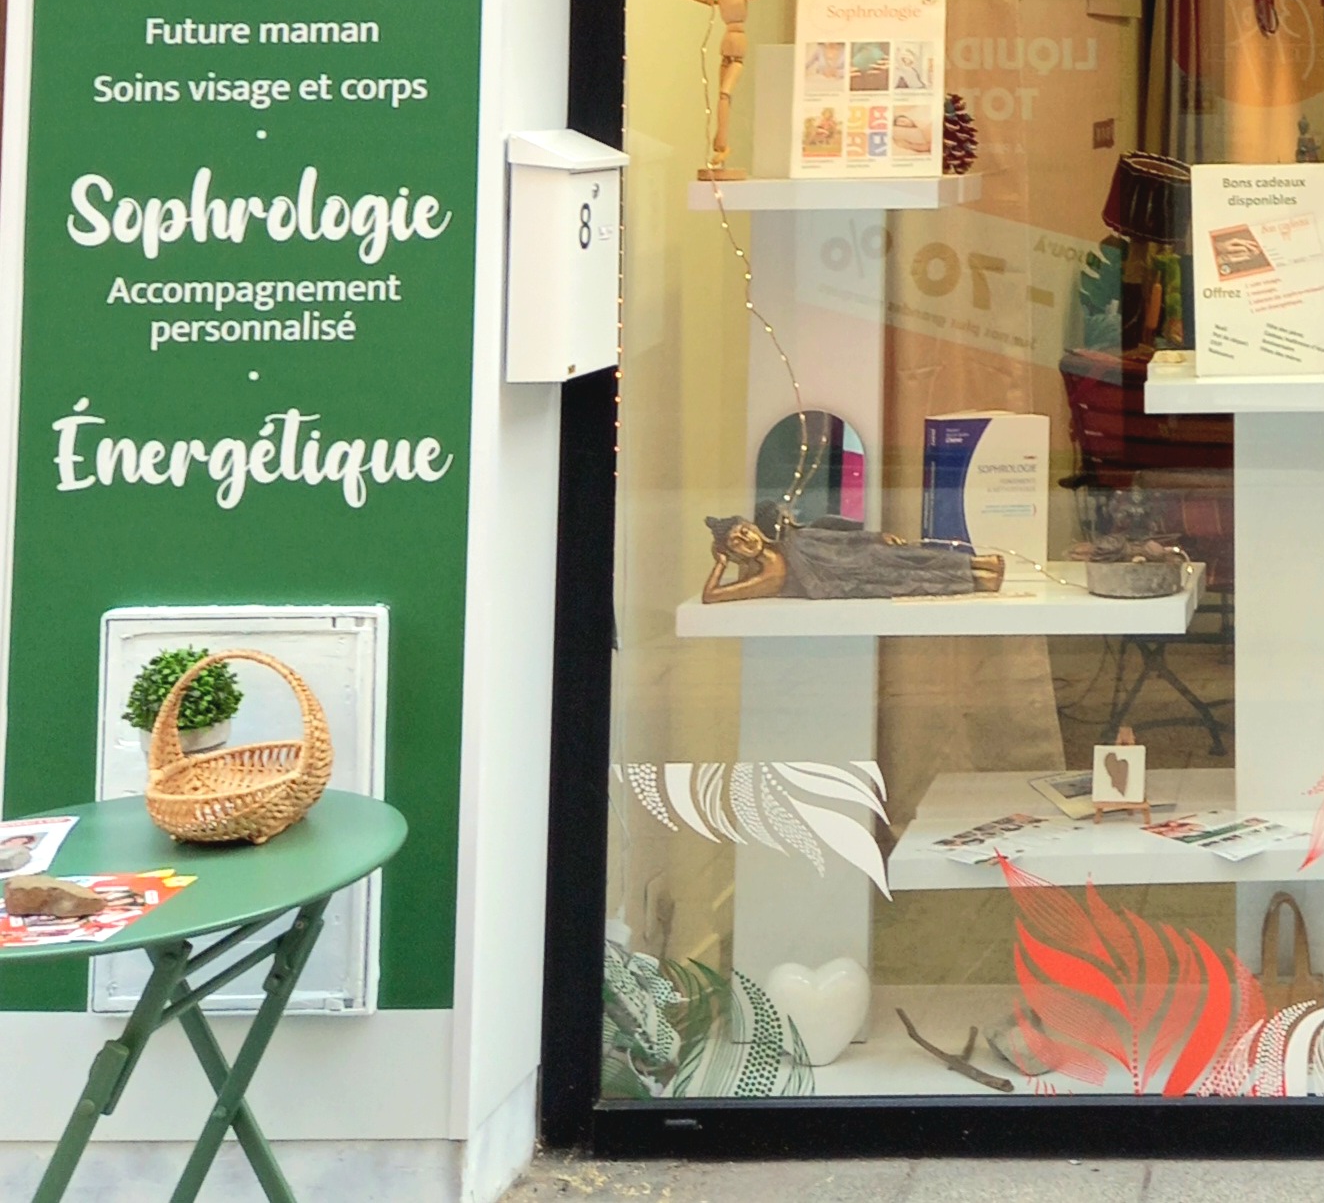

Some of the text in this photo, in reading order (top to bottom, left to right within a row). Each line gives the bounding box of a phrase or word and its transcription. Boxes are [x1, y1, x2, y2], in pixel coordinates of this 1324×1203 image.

[145, 17, 379, 45] Future maman
[826, 4, 923, 22] Sophrologie
[93, 71, 428, 110] Soins visage et corps
[1222, 177, 1306, 189] Bons cadeaux
[1228, 194, 1298, 208] disponibles
[66, 166, 452, 265] Sophrologie
[579, 202, 592, 250] 8
[106, 274, 402, 311] Accompagnement
[1202, 287, 1241, 299] Offrez
[150, 310, 357, 351] personnalisé
[52, 397, 454, 509] Énergétique
